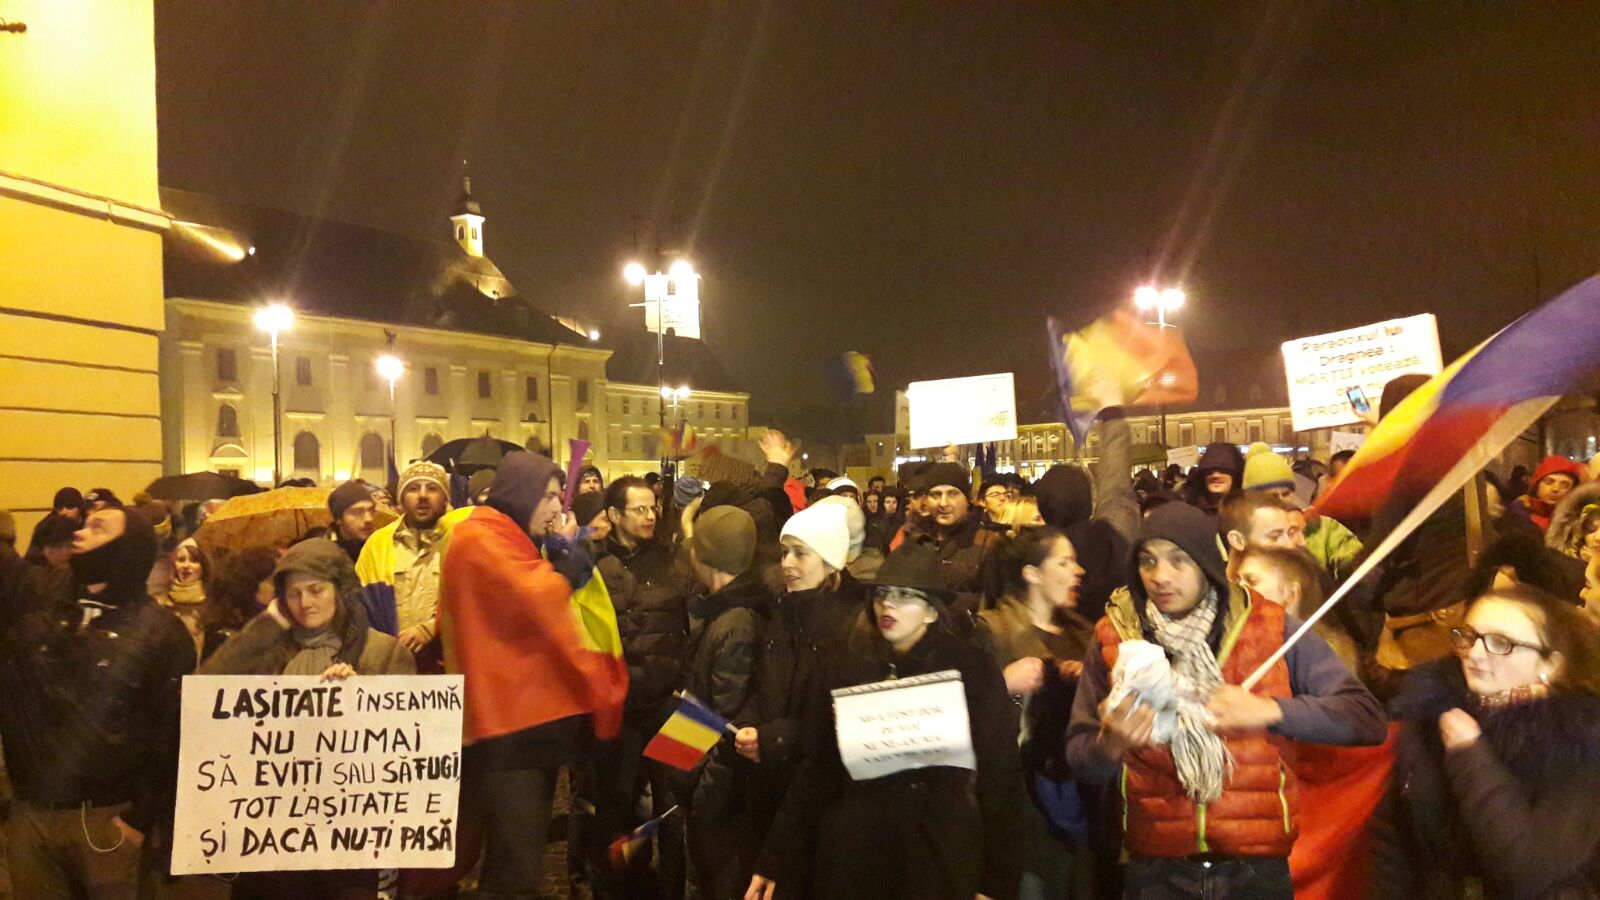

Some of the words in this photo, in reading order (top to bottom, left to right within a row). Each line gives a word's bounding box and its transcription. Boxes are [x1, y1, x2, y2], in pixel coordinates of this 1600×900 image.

[356, 684, 462, 712] ÎNSEAMNĂ
[250, 730, 295, 755] NU
[315, 722, 421, 754] NUMAI
[197, 754, 238, 791] SĂ
[254, 757, 322, 792] EVIȚI
[333, 762, 376, 785] SAU
[381, 756, 412, 784] SĂ
[230, 796, 282, 819] TOT
[425, 793, 442, 813] E
[240, 823, 319, 857] DACĂ
[400, 818, 453, 852] PASĂ
